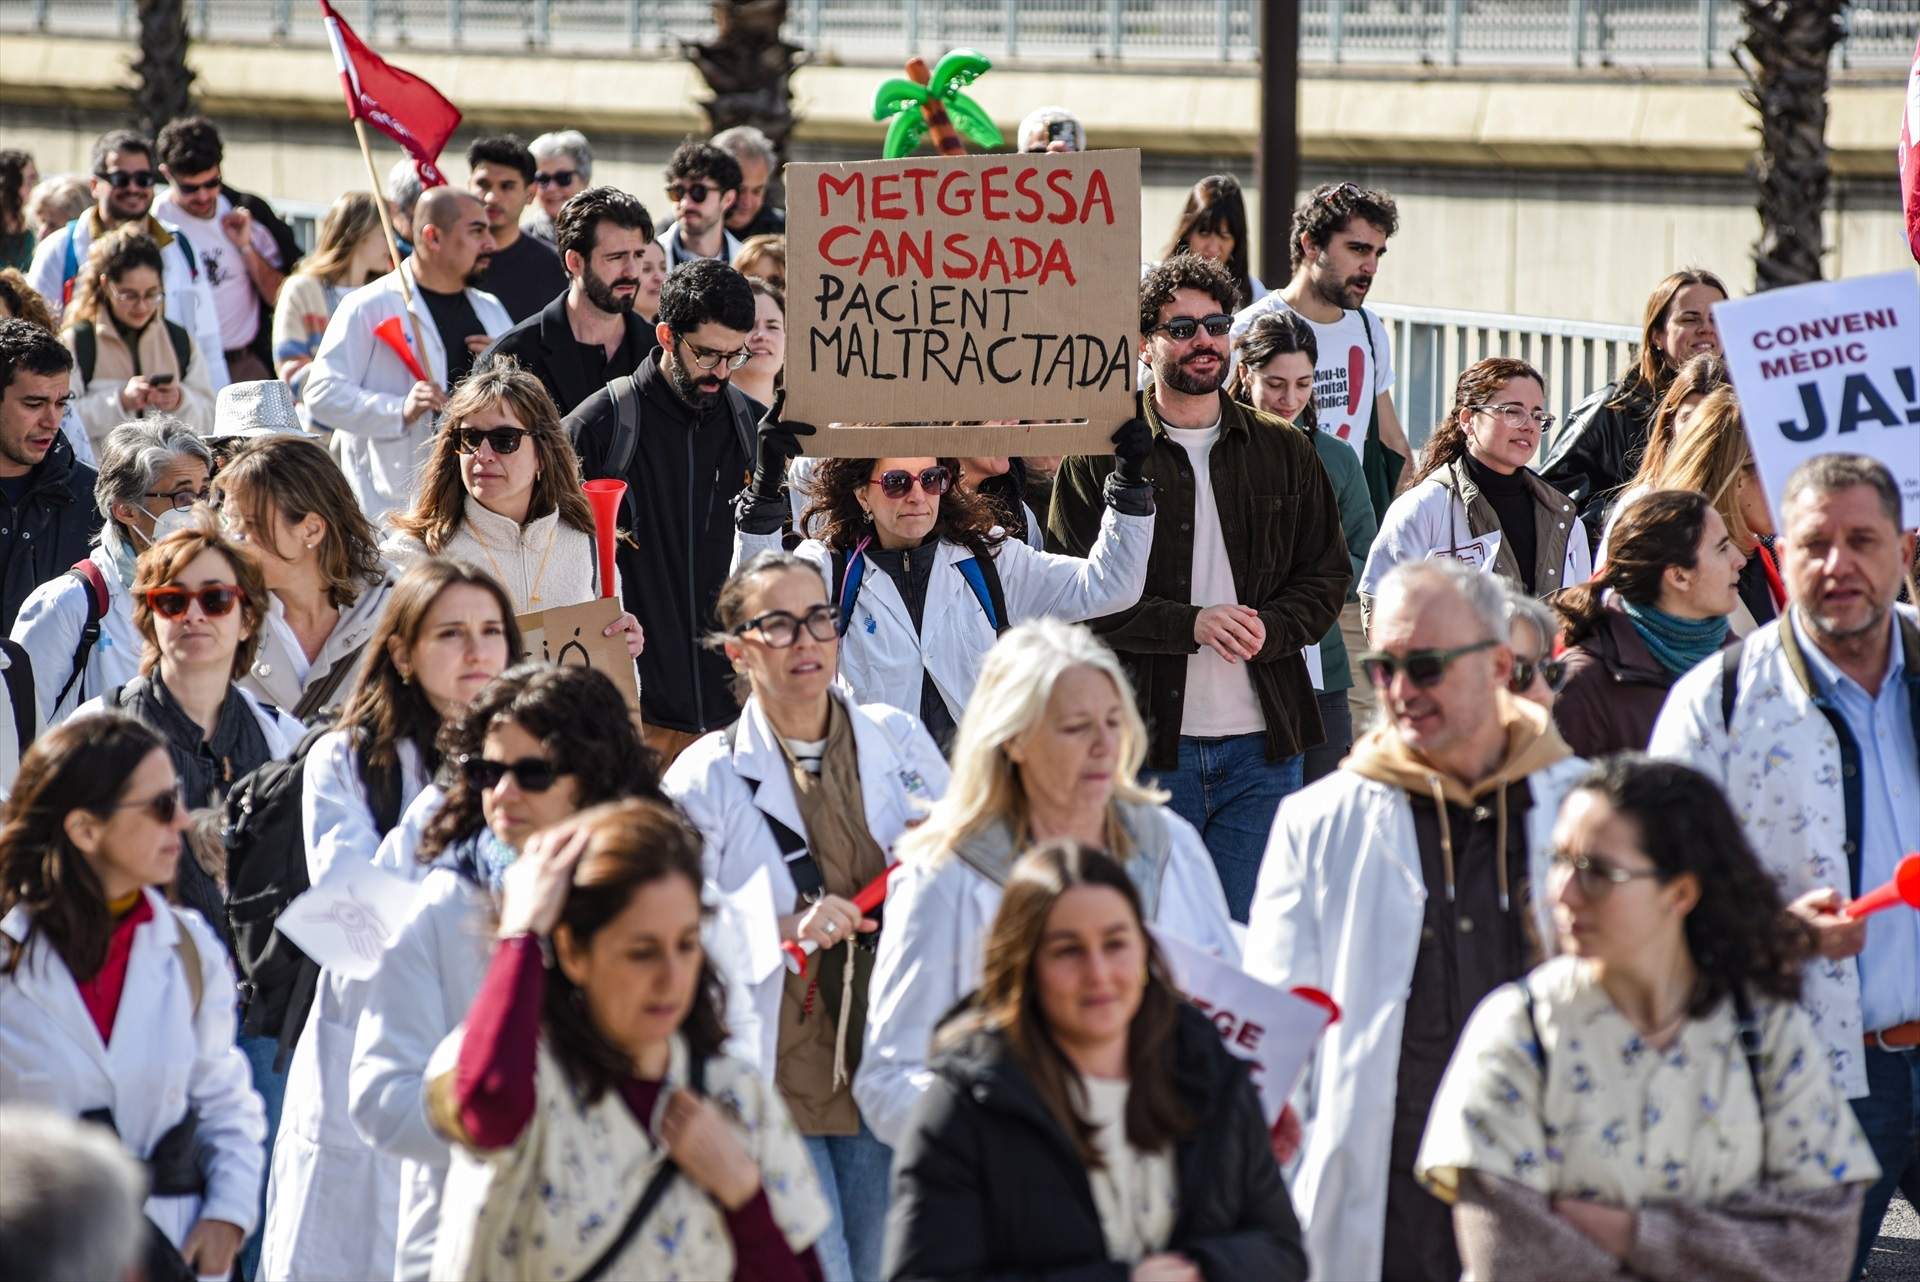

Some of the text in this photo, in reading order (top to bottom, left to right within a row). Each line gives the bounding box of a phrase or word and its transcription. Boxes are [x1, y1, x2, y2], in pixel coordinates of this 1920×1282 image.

[817, 166, 1115, 225] METGESSA
[817, 225, 1077, 287] CANSADA
[809, 322, 1131, 392] MALTRACTADA
[1752, 307, 1898, 350] CONVENI
[1759, 342, 1868, 380] MÈDIC
